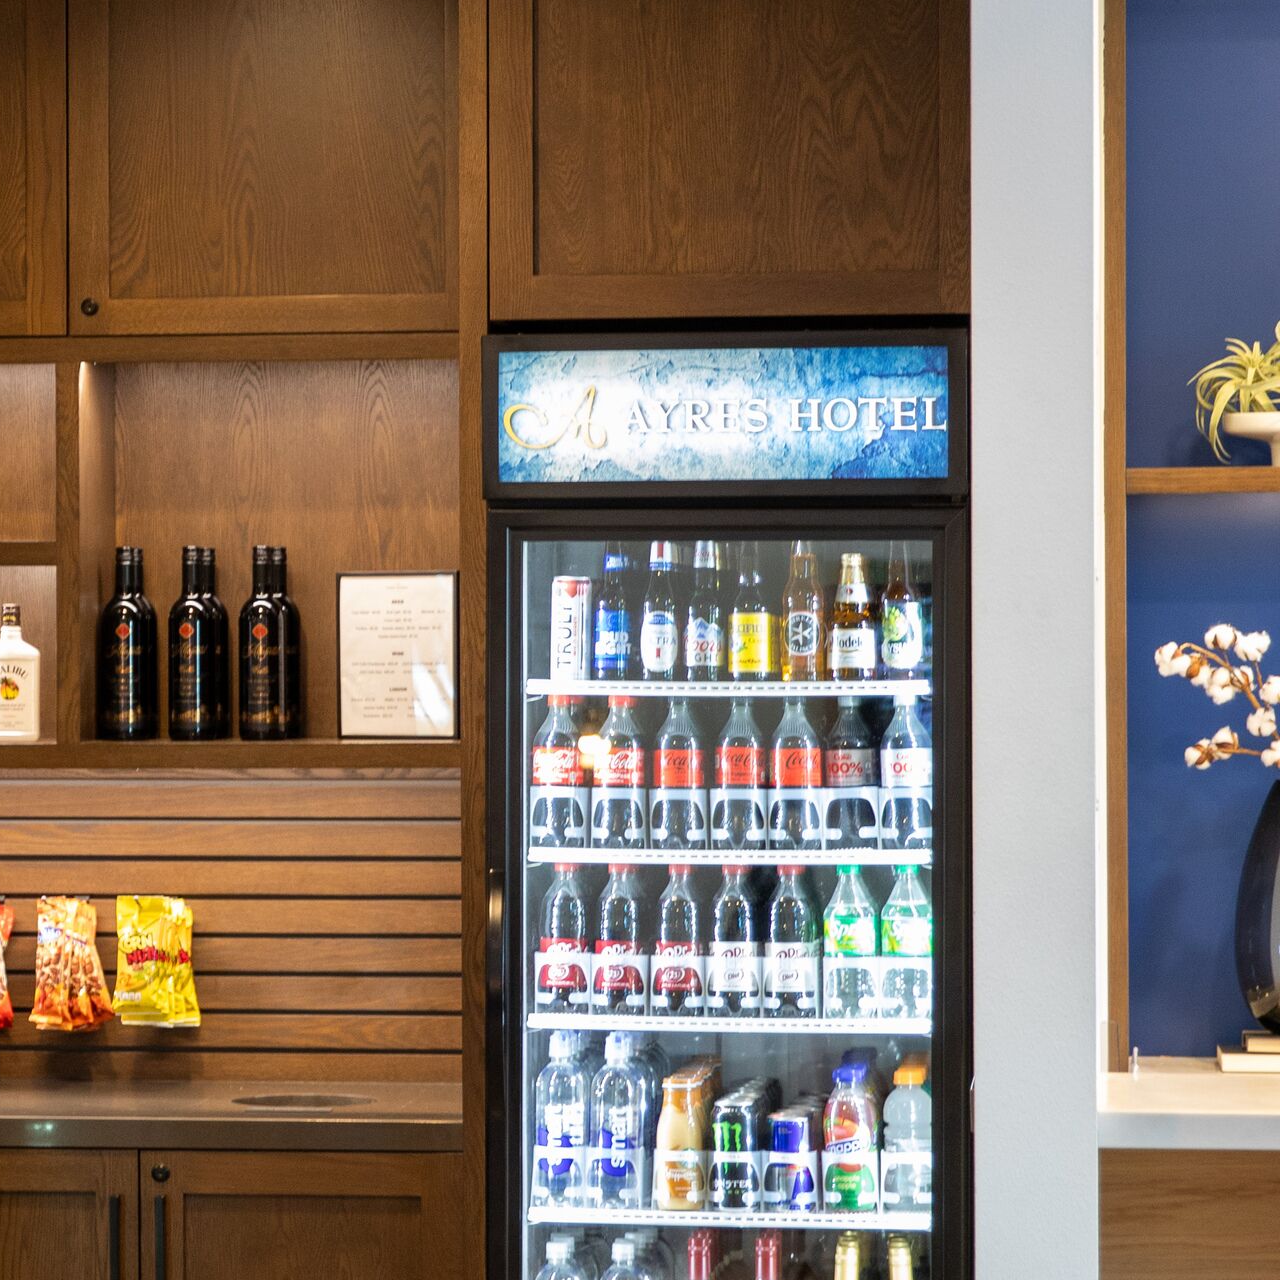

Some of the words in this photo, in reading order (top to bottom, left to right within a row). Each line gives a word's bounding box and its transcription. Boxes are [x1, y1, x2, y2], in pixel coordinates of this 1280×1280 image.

[626, 397, 768, 433] AYRES
[788, 396, 948, 432] HOTEL
[118, 932, 154, 954] CORN
